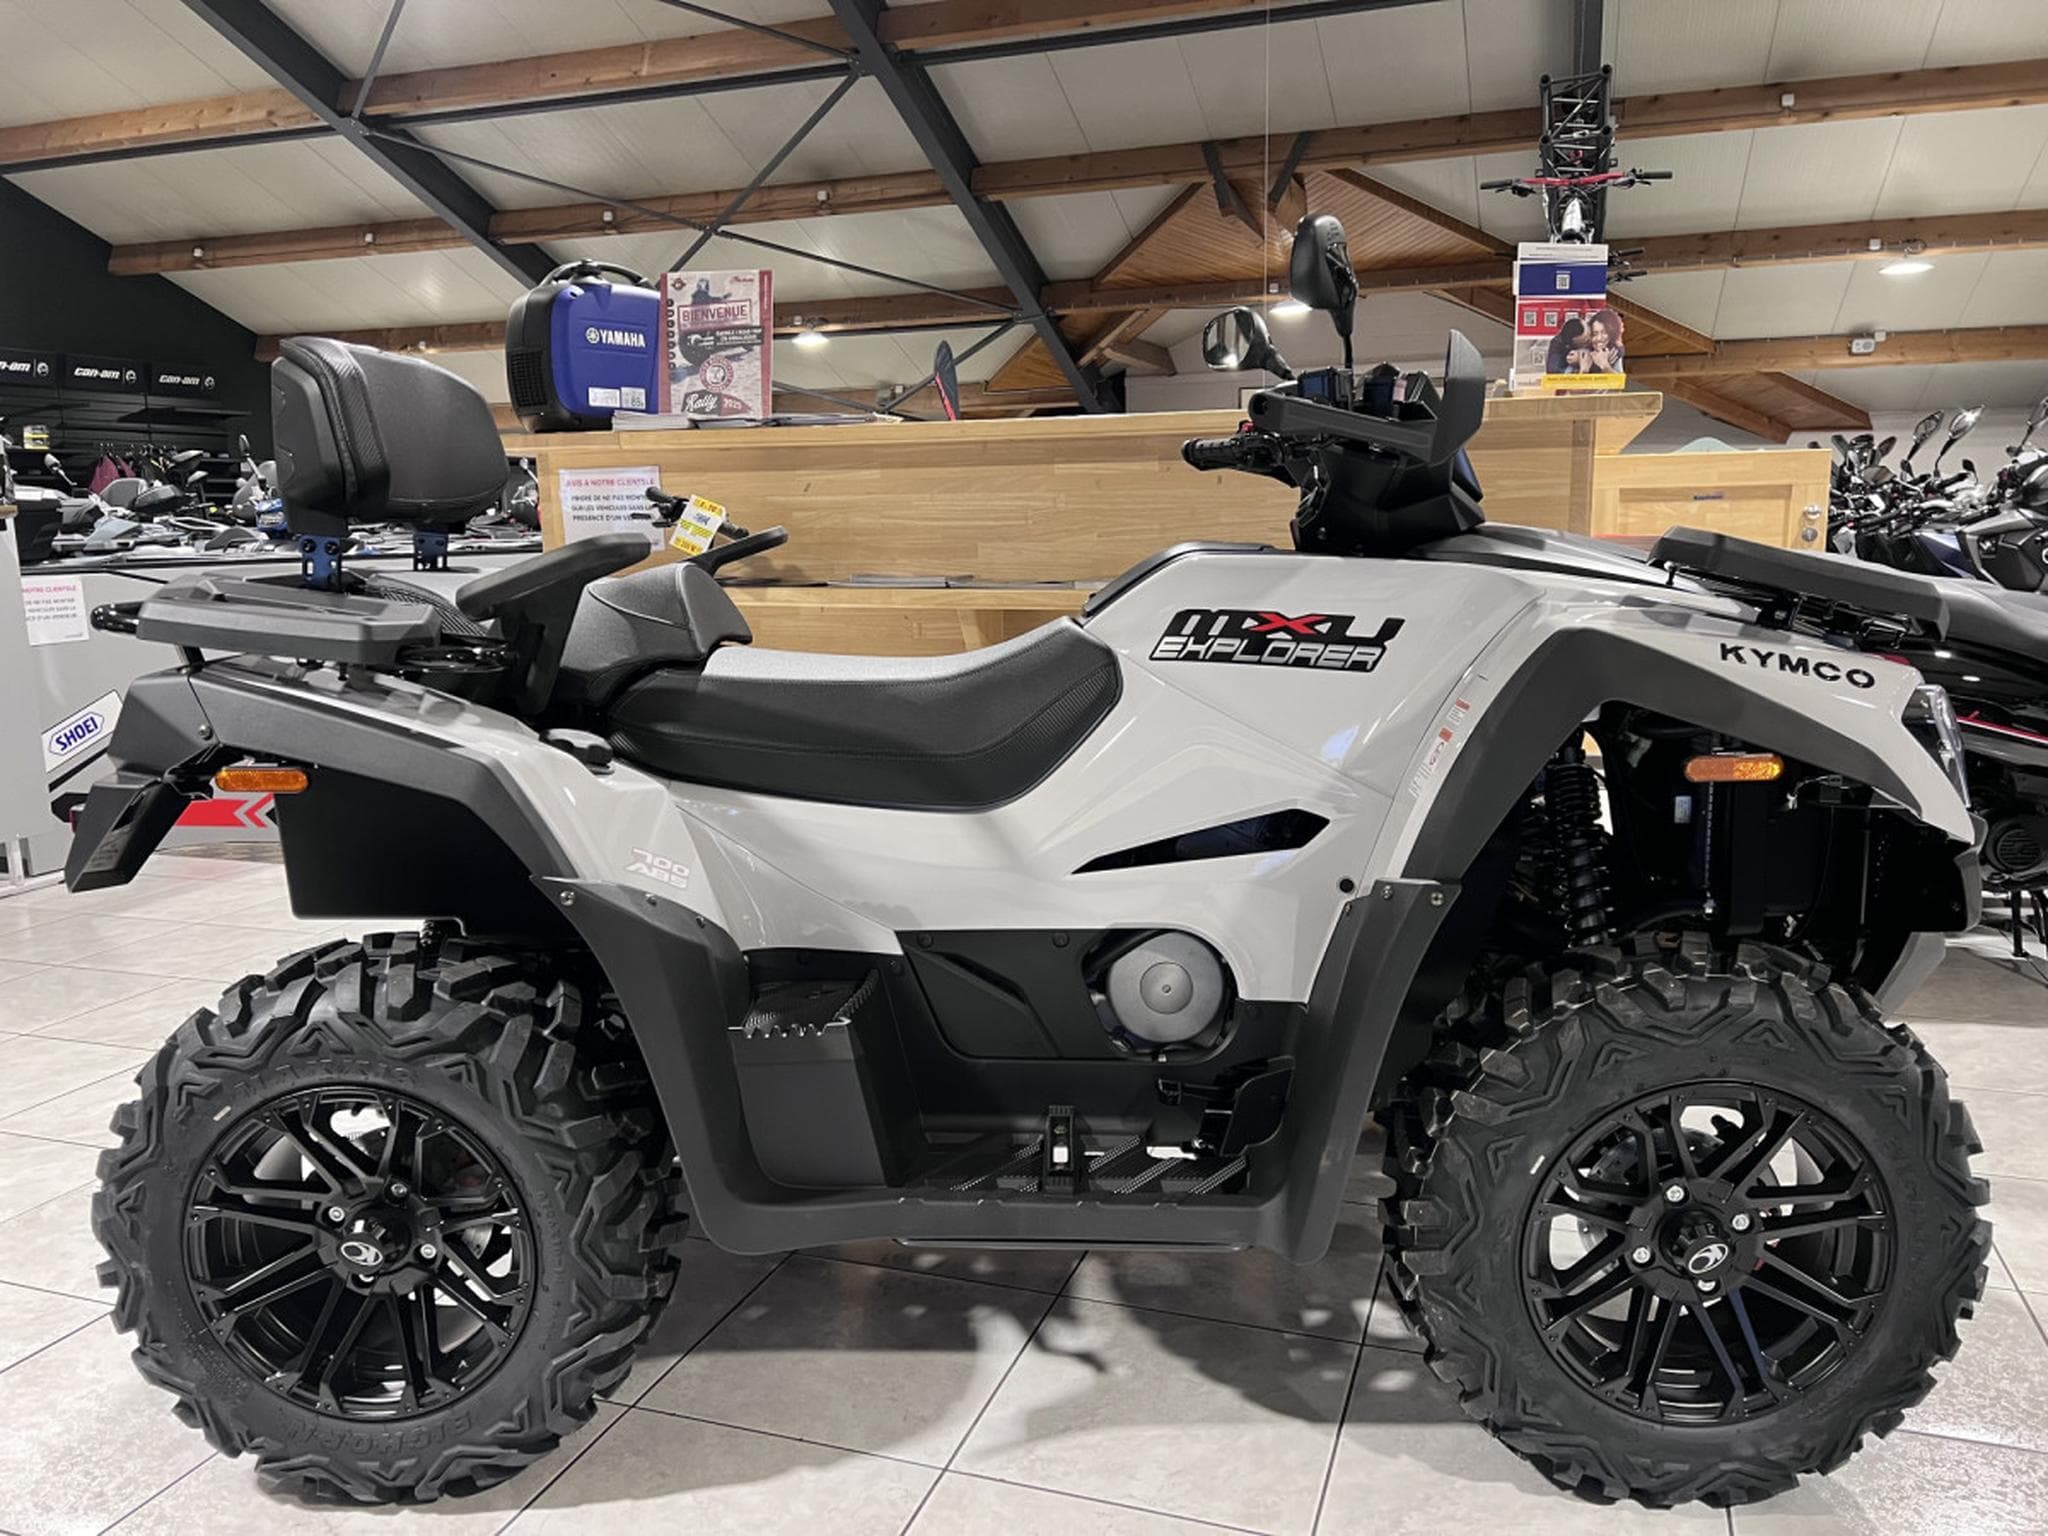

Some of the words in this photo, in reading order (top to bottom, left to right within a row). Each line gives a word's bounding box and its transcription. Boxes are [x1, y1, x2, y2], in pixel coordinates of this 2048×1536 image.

[681, 303, 748, 323] BIENVENUE
[600, 328, 646, 349] YAMAHA
[74, 366, 120, 380] can-am
[159, 373, 200, 386] can-am
[591, 478, 615, 487] NOTRE
[1162, 608, 1406, 647] MXU
[1149, 634, 1387, 673] EXPLORER
[1719, 643, 1875, 689] KYMCO
[55, 716, 99, 752] SHOEI
[632, 847, 691, 877] 700
